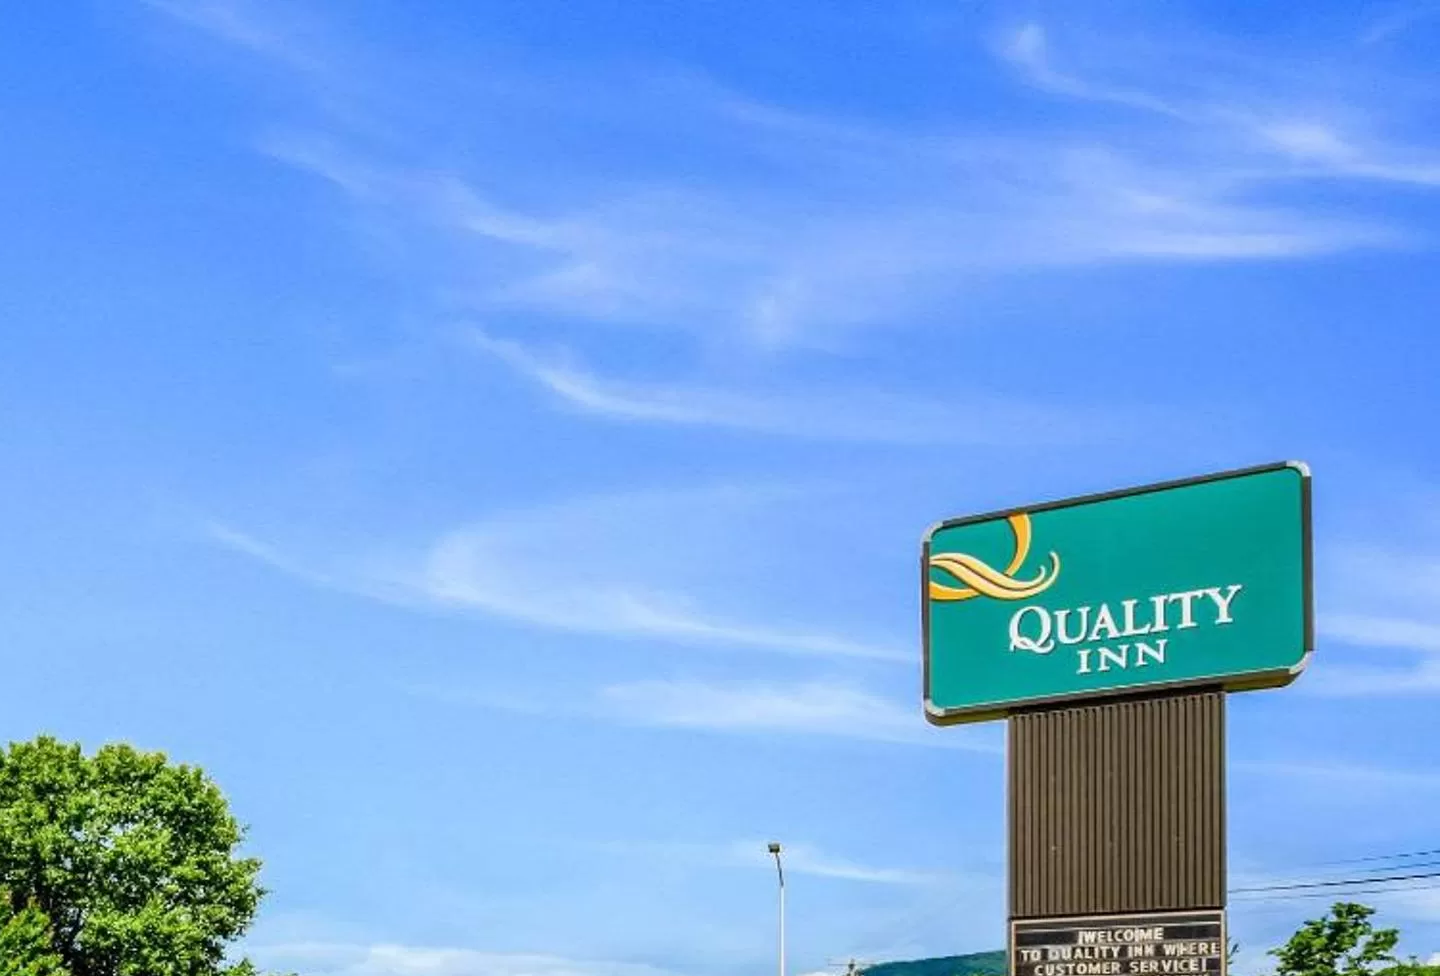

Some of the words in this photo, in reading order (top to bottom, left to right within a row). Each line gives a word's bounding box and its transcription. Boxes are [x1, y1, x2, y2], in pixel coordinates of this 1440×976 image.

[1008, 584, 1243, 655] QUALITY
[1076, 638, 1168, 675] INN
[1082, 927, 1164, 944] WELCOME
[1021, 949, 1041, 961] TO
[1047, 945, 1120, 961] QUALITY
[1127, 944, 1155, 958] INN
[1163, 942, 1220, 957] WHERE
[1034, 962, 1121, 976] CUSTOMER
